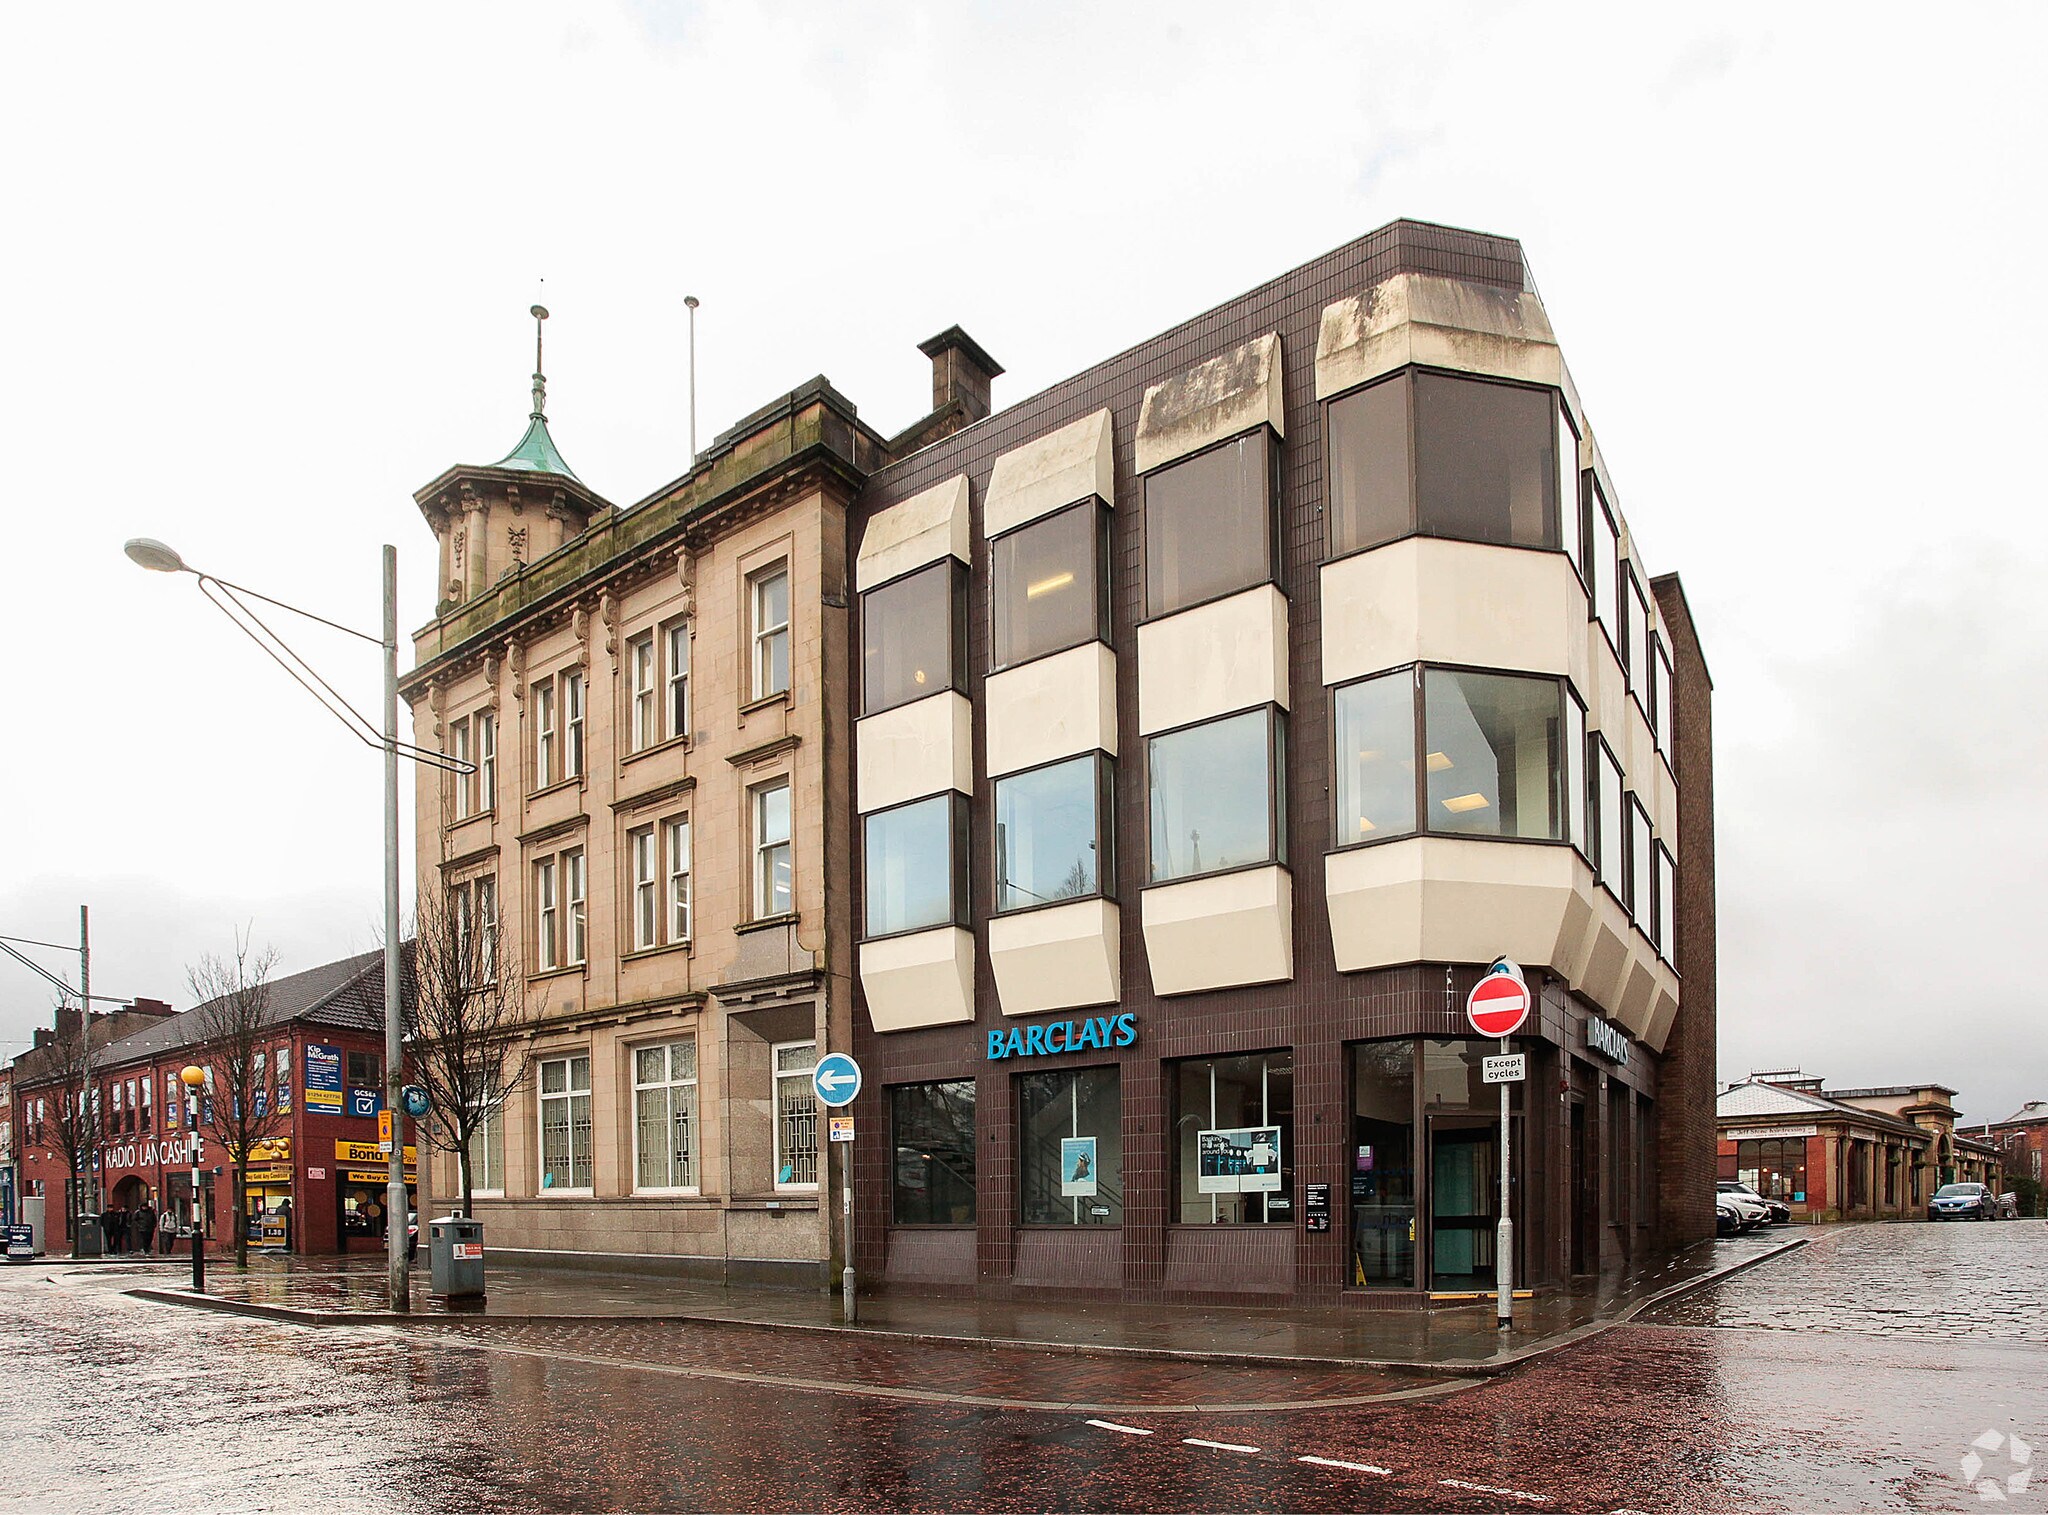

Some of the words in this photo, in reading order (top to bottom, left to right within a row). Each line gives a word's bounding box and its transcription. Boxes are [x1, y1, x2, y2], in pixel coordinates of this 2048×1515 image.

[987, 1013, 1136, 1060] BARCLAYS
[1594, 1016, 1628, 1065] BARCLAYS
[307, 1045, 321, 1053] Kip
[307, 1051, 339, 1061] McGrath
[1486, 1058, 1521, 1068] Except
[1488, 1069, 1520, 1079] cycles
[354, 1089, 376, 1098] GCSEs
[105, 1143, 137, 1169] RADIO
[139, 1138, 205, 1167] LANCASHIE
[349, 1148, 383, 1161] Bond
